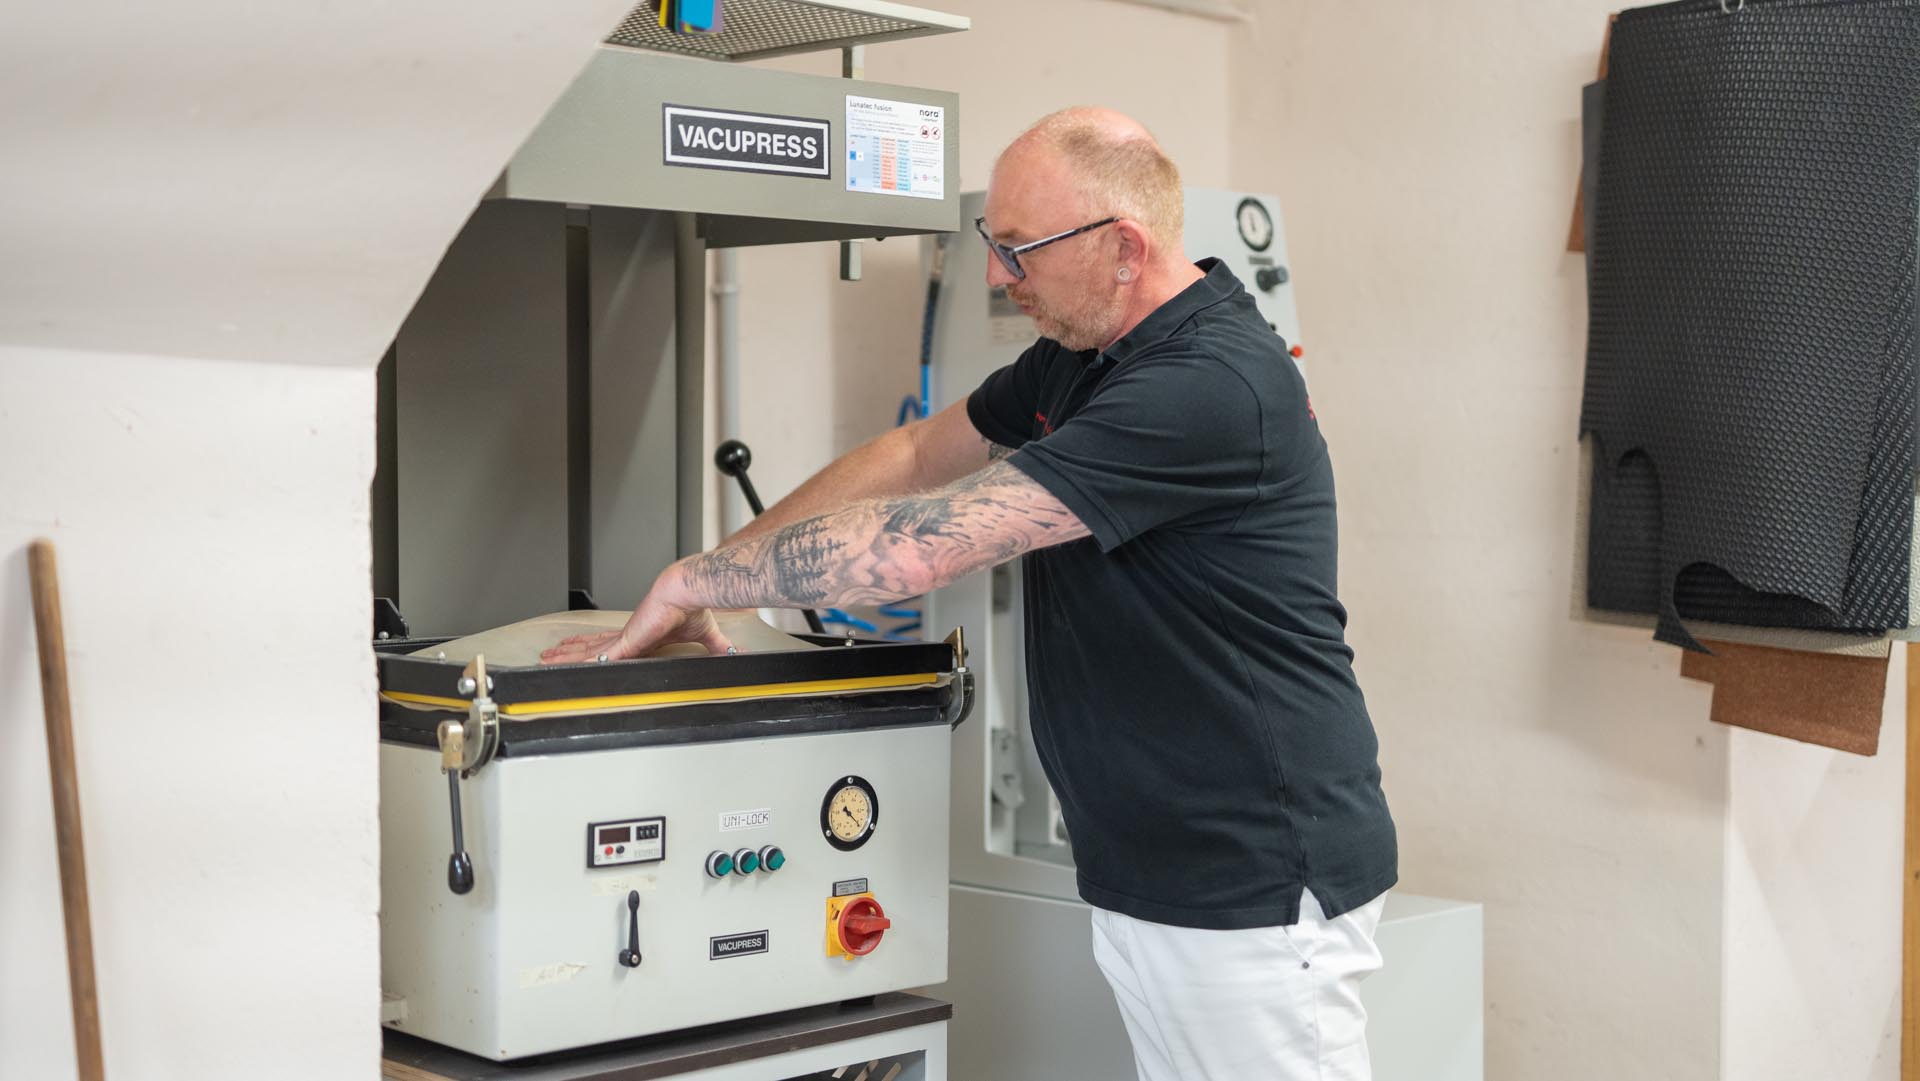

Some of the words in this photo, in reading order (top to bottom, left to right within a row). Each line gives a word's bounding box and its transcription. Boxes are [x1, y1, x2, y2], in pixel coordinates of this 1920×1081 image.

[849, 100, 873, 109] Lunatec
[874, 103, 893, 112] fusion
[919, 109, 939, 118] nora
[678, 124, 818, 160] VACUPRESS
[723, 812, 769, 828] UNI-LOCK
[717, 937, 763, 952] VACUPRESS
